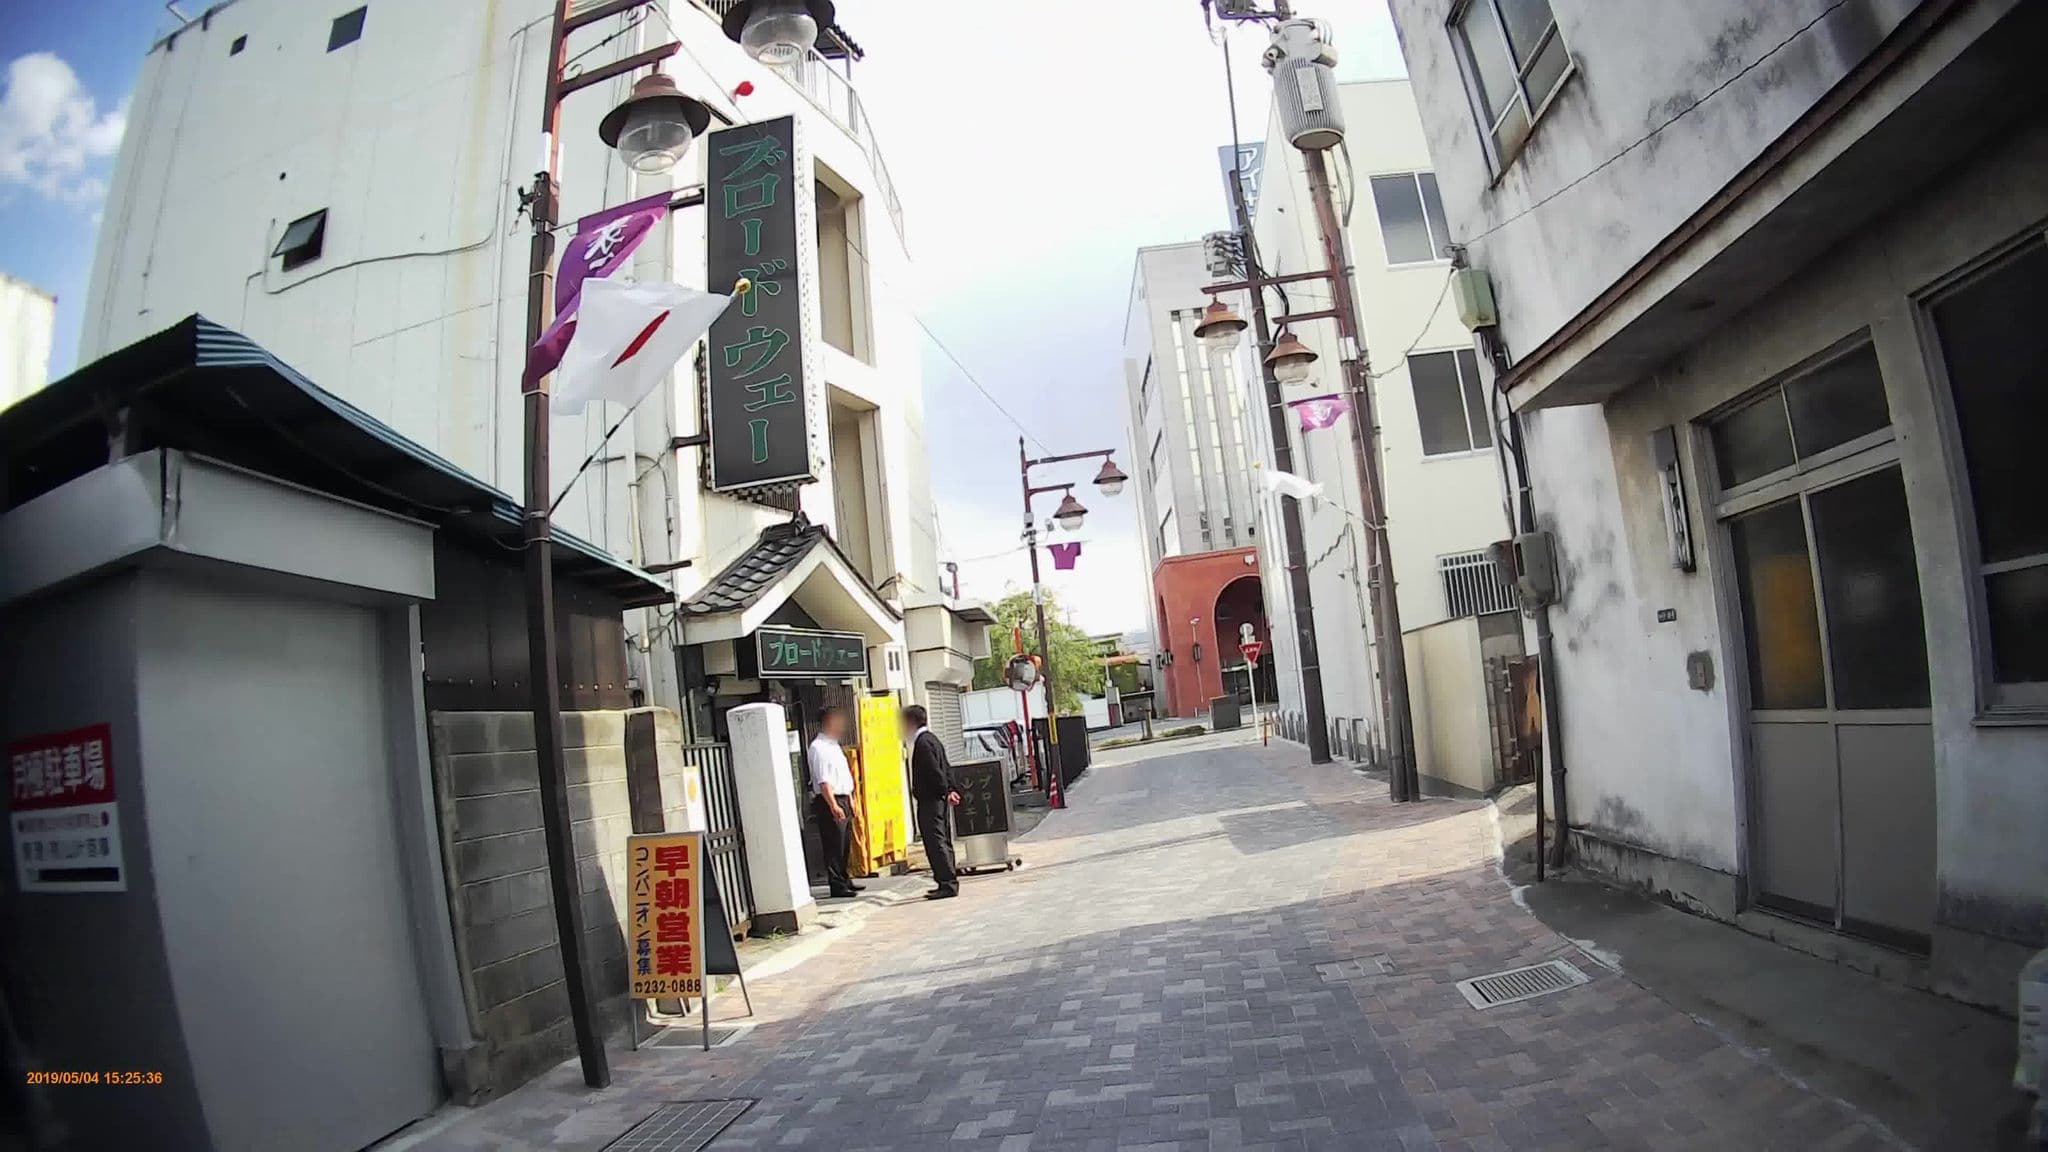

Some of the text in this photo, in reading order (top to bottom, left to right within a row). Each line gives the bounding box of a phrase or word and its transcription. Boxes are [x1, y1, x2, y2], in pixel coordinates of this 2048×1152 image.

[719, 134, 797, 464] ブロードウェー
[654, 845, 692, 976] 早朝営業
[644, 978, 702, 993] 232-0888
